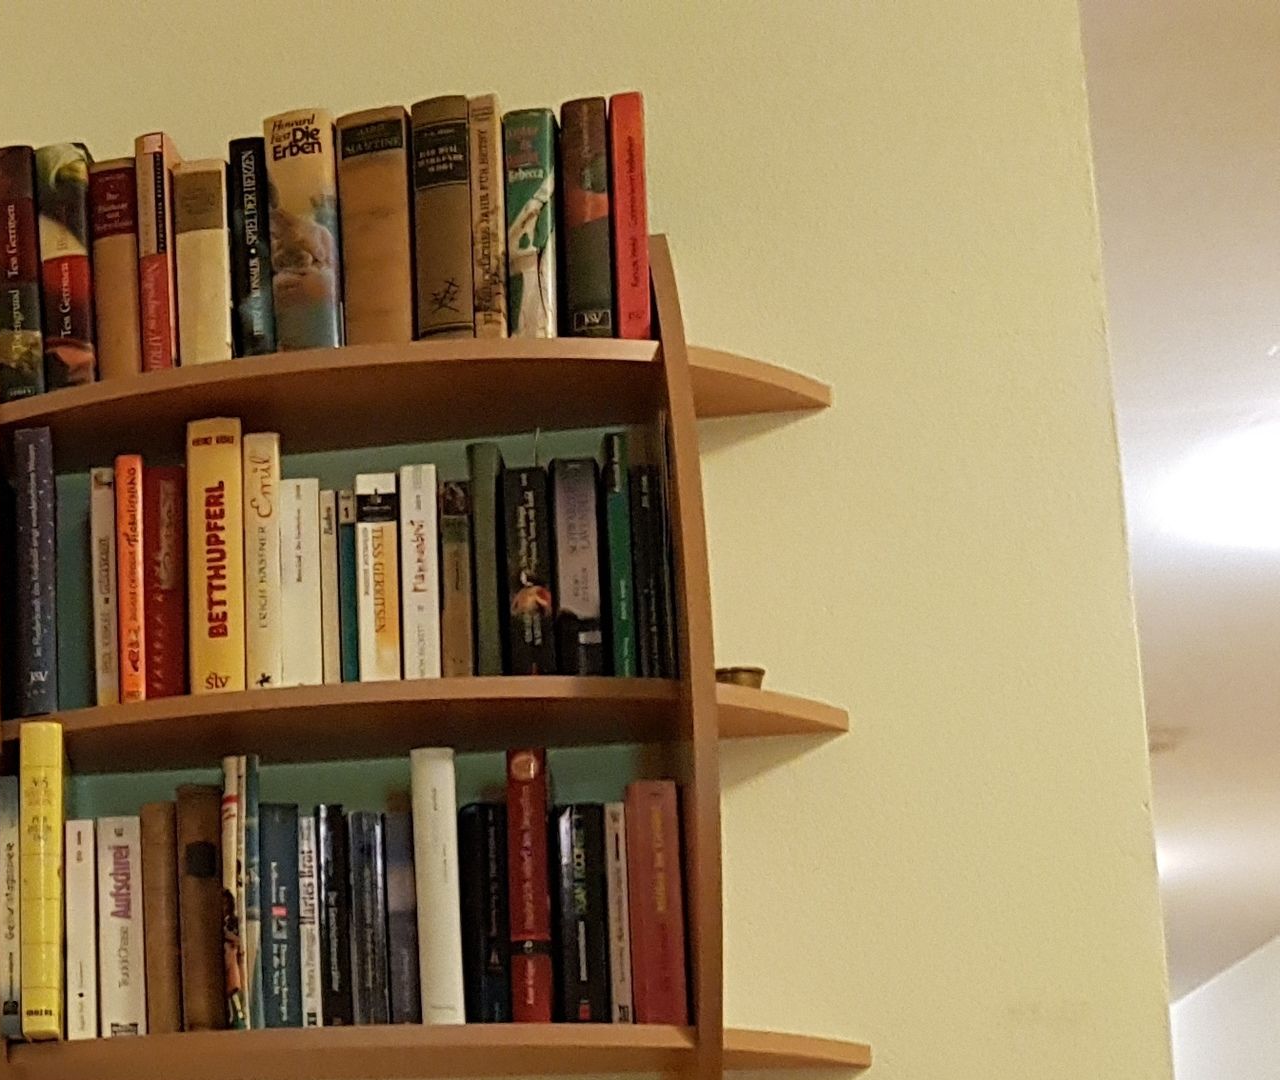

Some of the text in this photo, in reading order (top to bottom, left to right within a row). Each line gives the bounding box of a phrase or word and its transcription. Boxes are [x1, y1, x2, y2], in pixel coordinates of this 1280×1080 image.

[273, 138, 323, 161] Erben
[292, 125, 321, 142] Die
[241, 149, 256, 192] HERZEN
[243, 193, 258, 215] DER
[6, 203, 18, 254] Gerritsen
[244, 214, 259, 245] SPIEL
[7, 256, 19, 277] Tess
[59, 262, 72, 338] Tess Gerritsen
[249, 455, 274, 519] Emil
[204, 479, 229, 639] BETTHUPFERL
[371, 526, 388, 634] TESS GERRITSEN
[108, 843, 132, 920] Aufschrei
